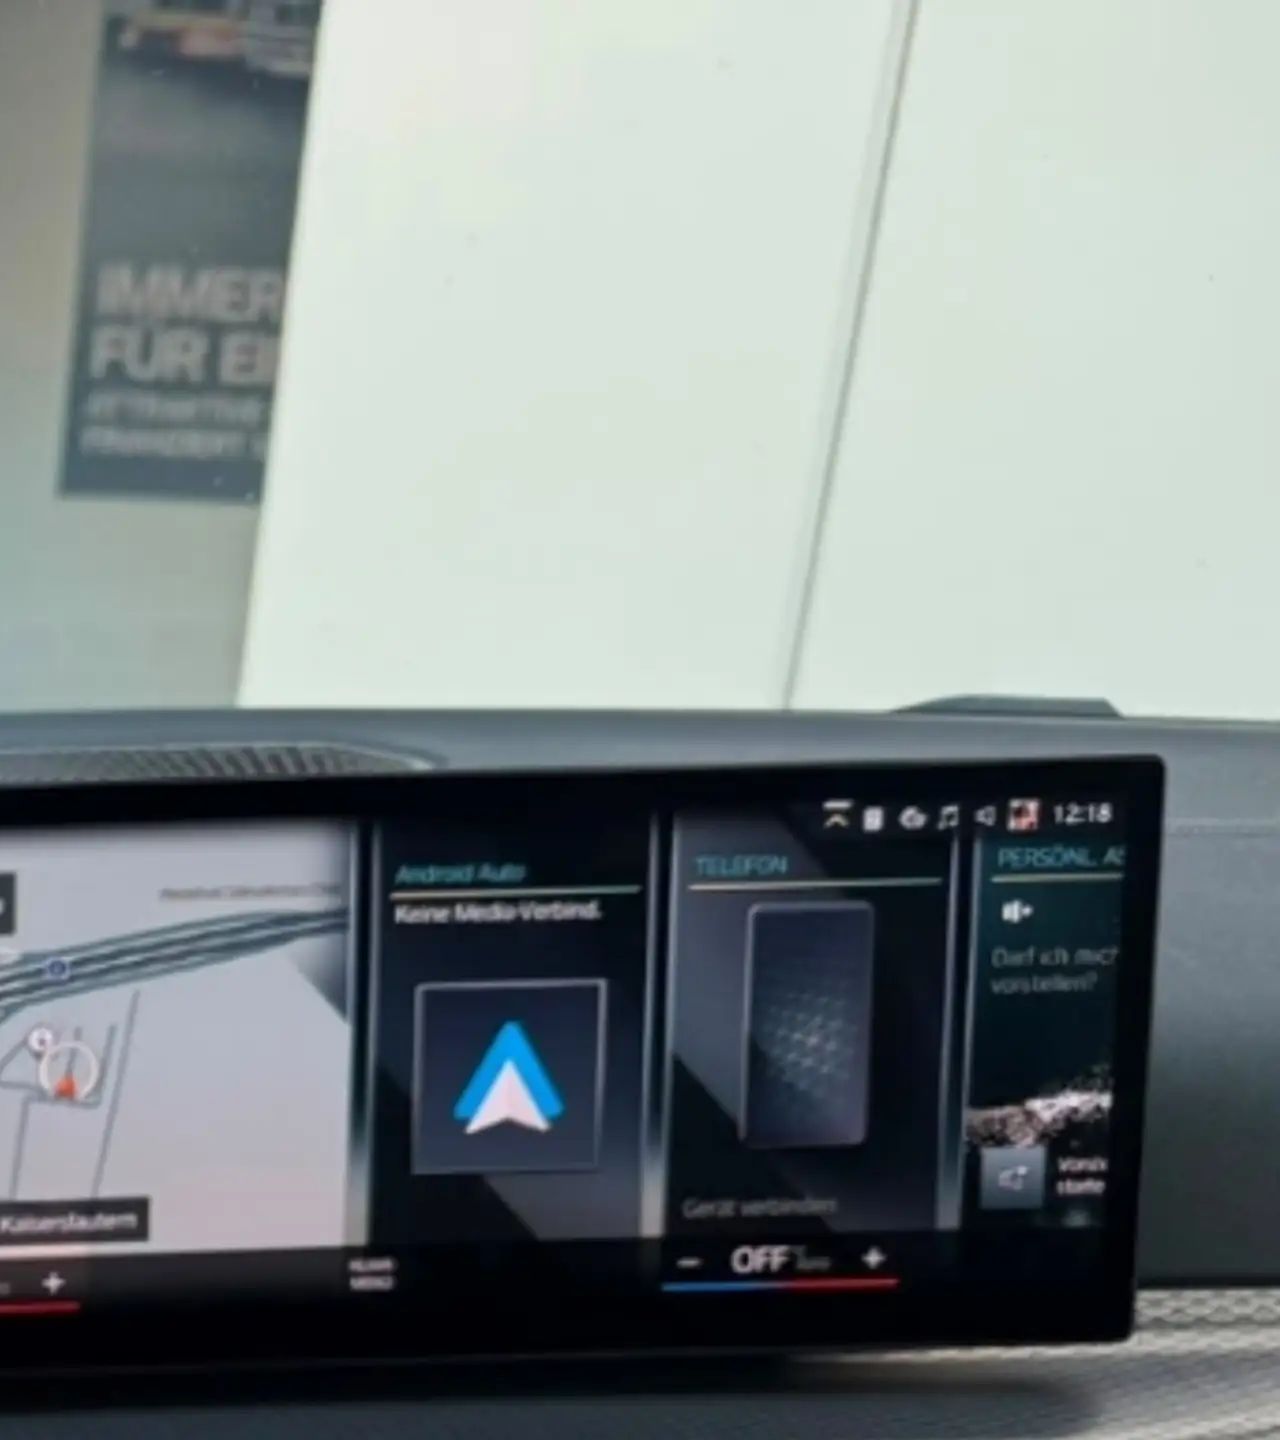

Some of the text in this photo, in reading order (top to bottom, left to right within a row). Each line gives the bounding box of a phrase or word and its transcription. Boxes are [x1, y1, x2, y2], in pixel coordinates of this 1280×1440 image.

[95, 262, 285, 325] IMMER
[1053, 802, 1114, 825] 12:18
[395, 863, 527, 885] Android Auto
[695, 855, 789, 877] TELEFON
[395, 902, 450, 924] Keine
[730, 1244, 790, 1274] OFF
